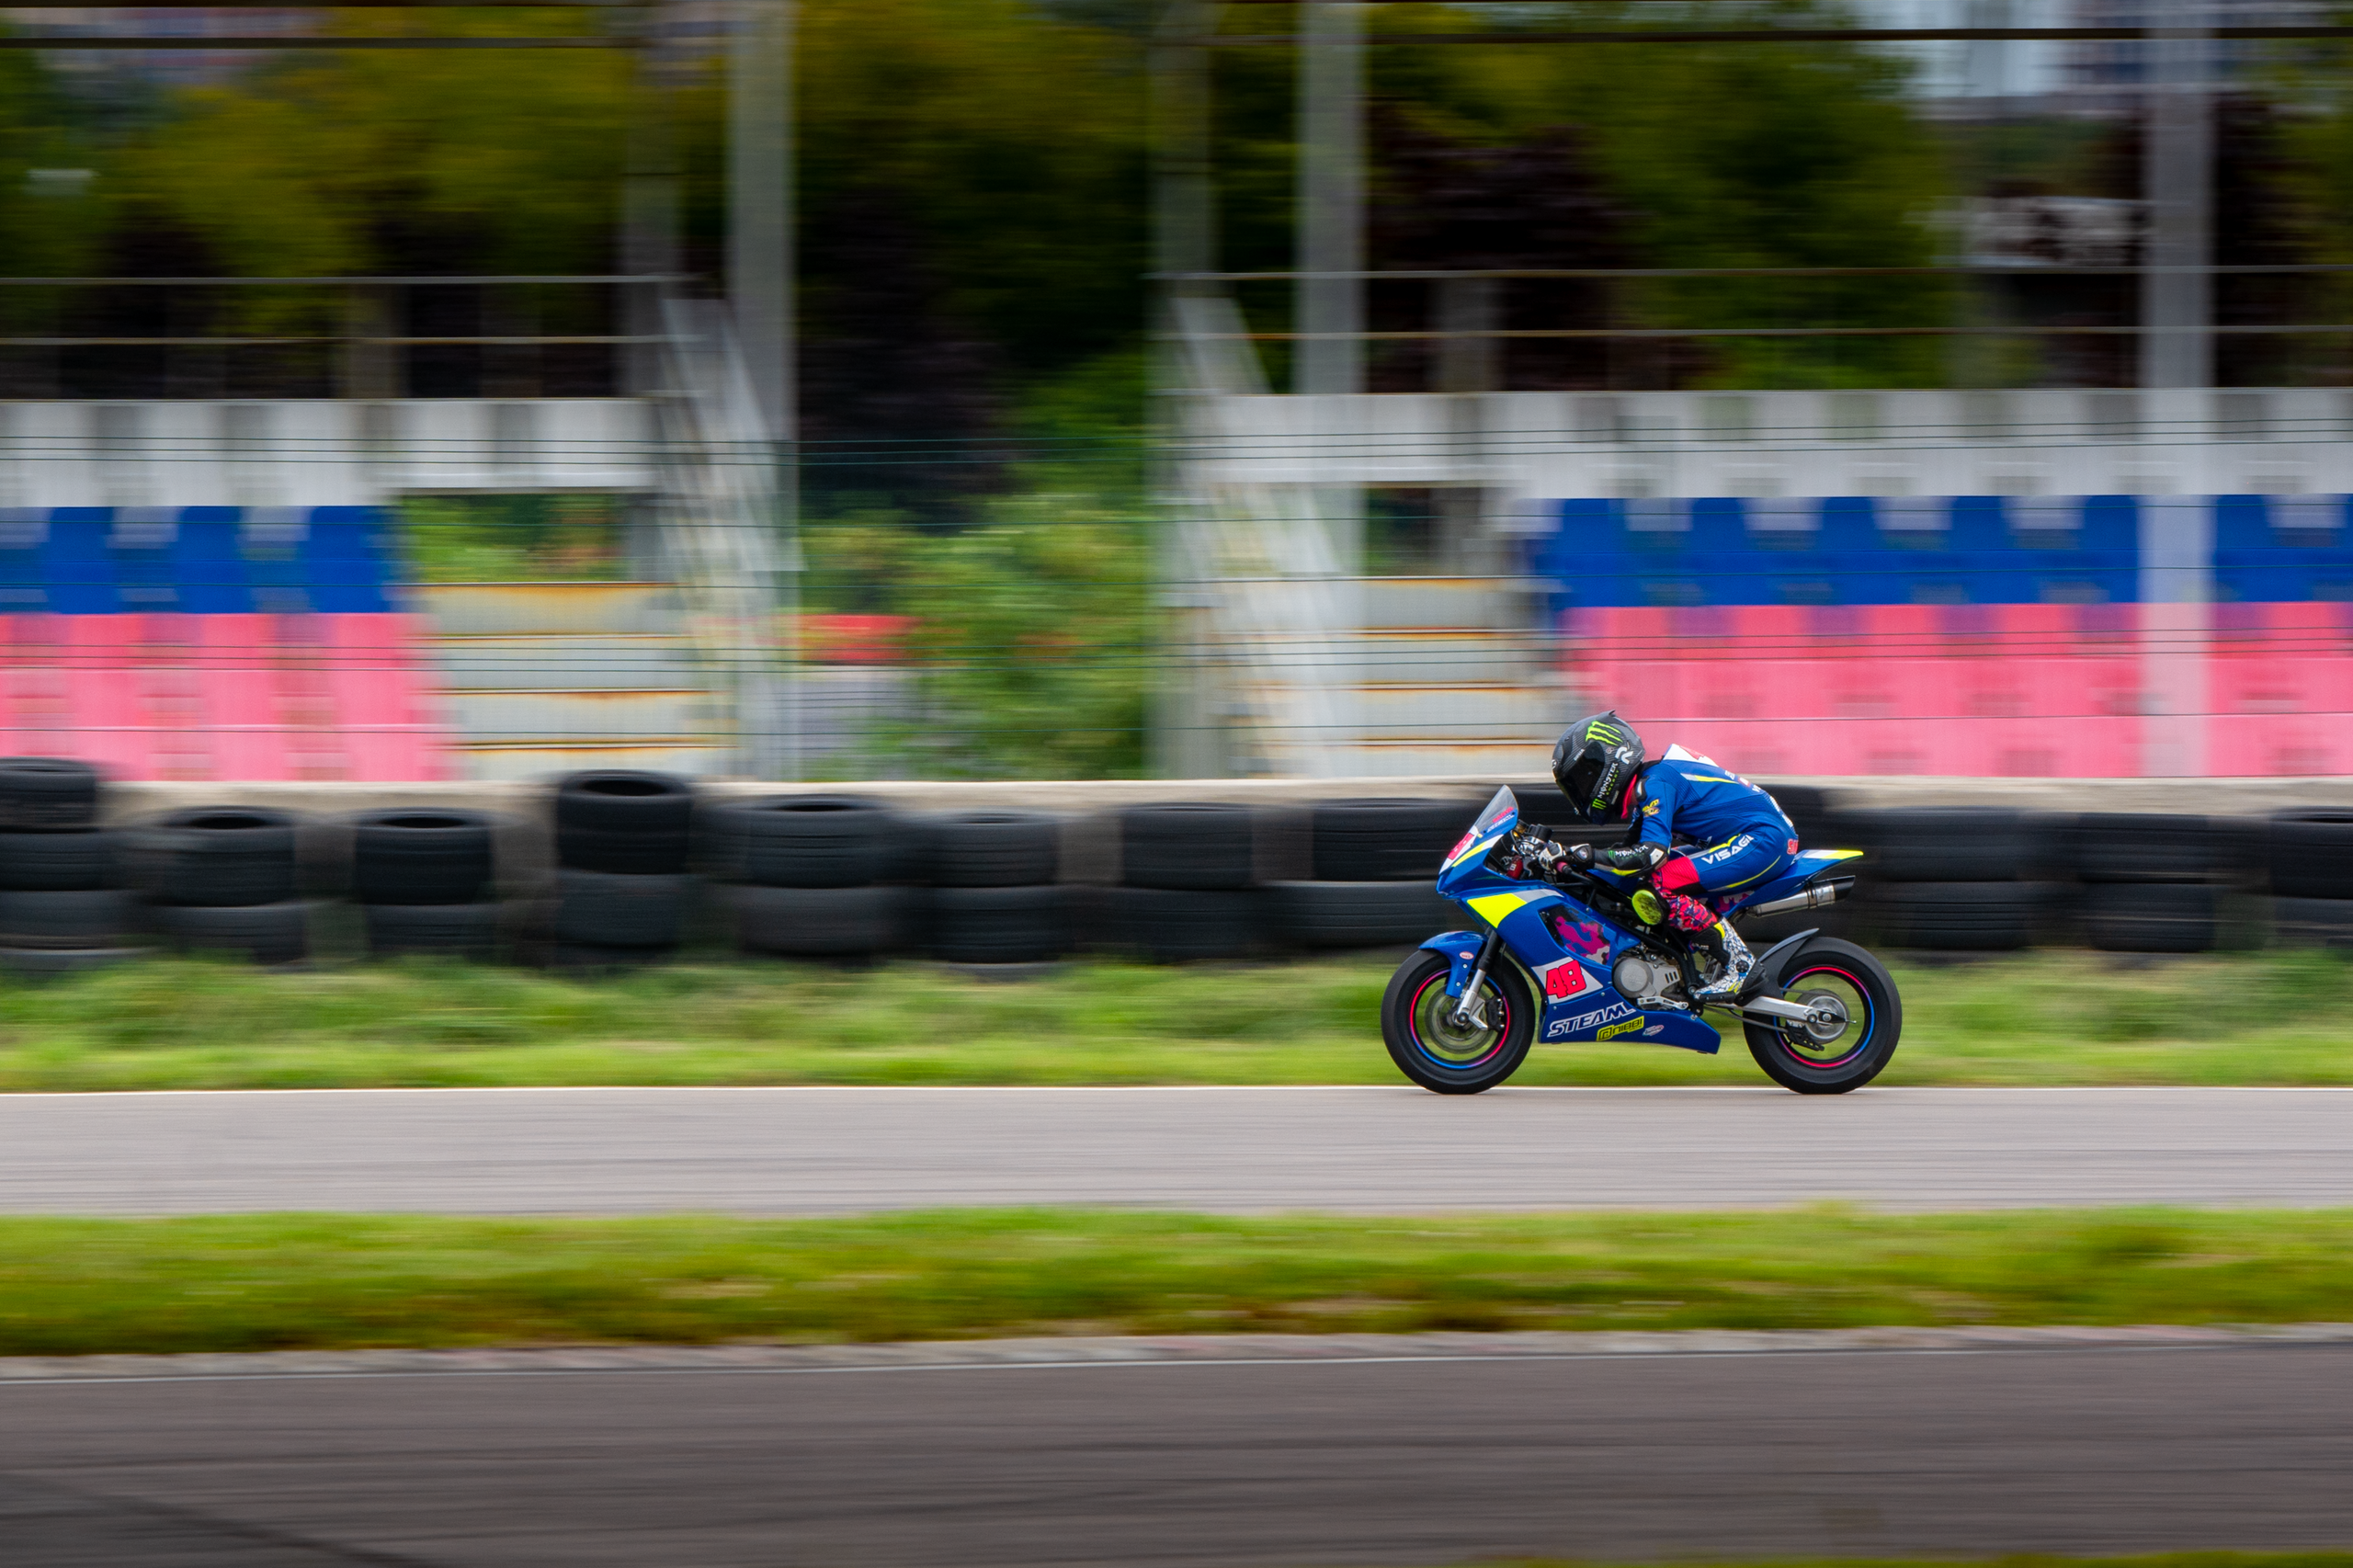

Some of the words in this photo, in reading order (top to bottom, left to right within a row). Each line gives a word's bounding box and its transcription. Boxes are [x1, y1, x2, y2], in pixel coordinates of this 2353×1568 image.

[1597, 762, 1618, 799] MONSTER
[1546, 960, 1587, 999] 48
[1547, 1002, 1636, 1038] STEAM
